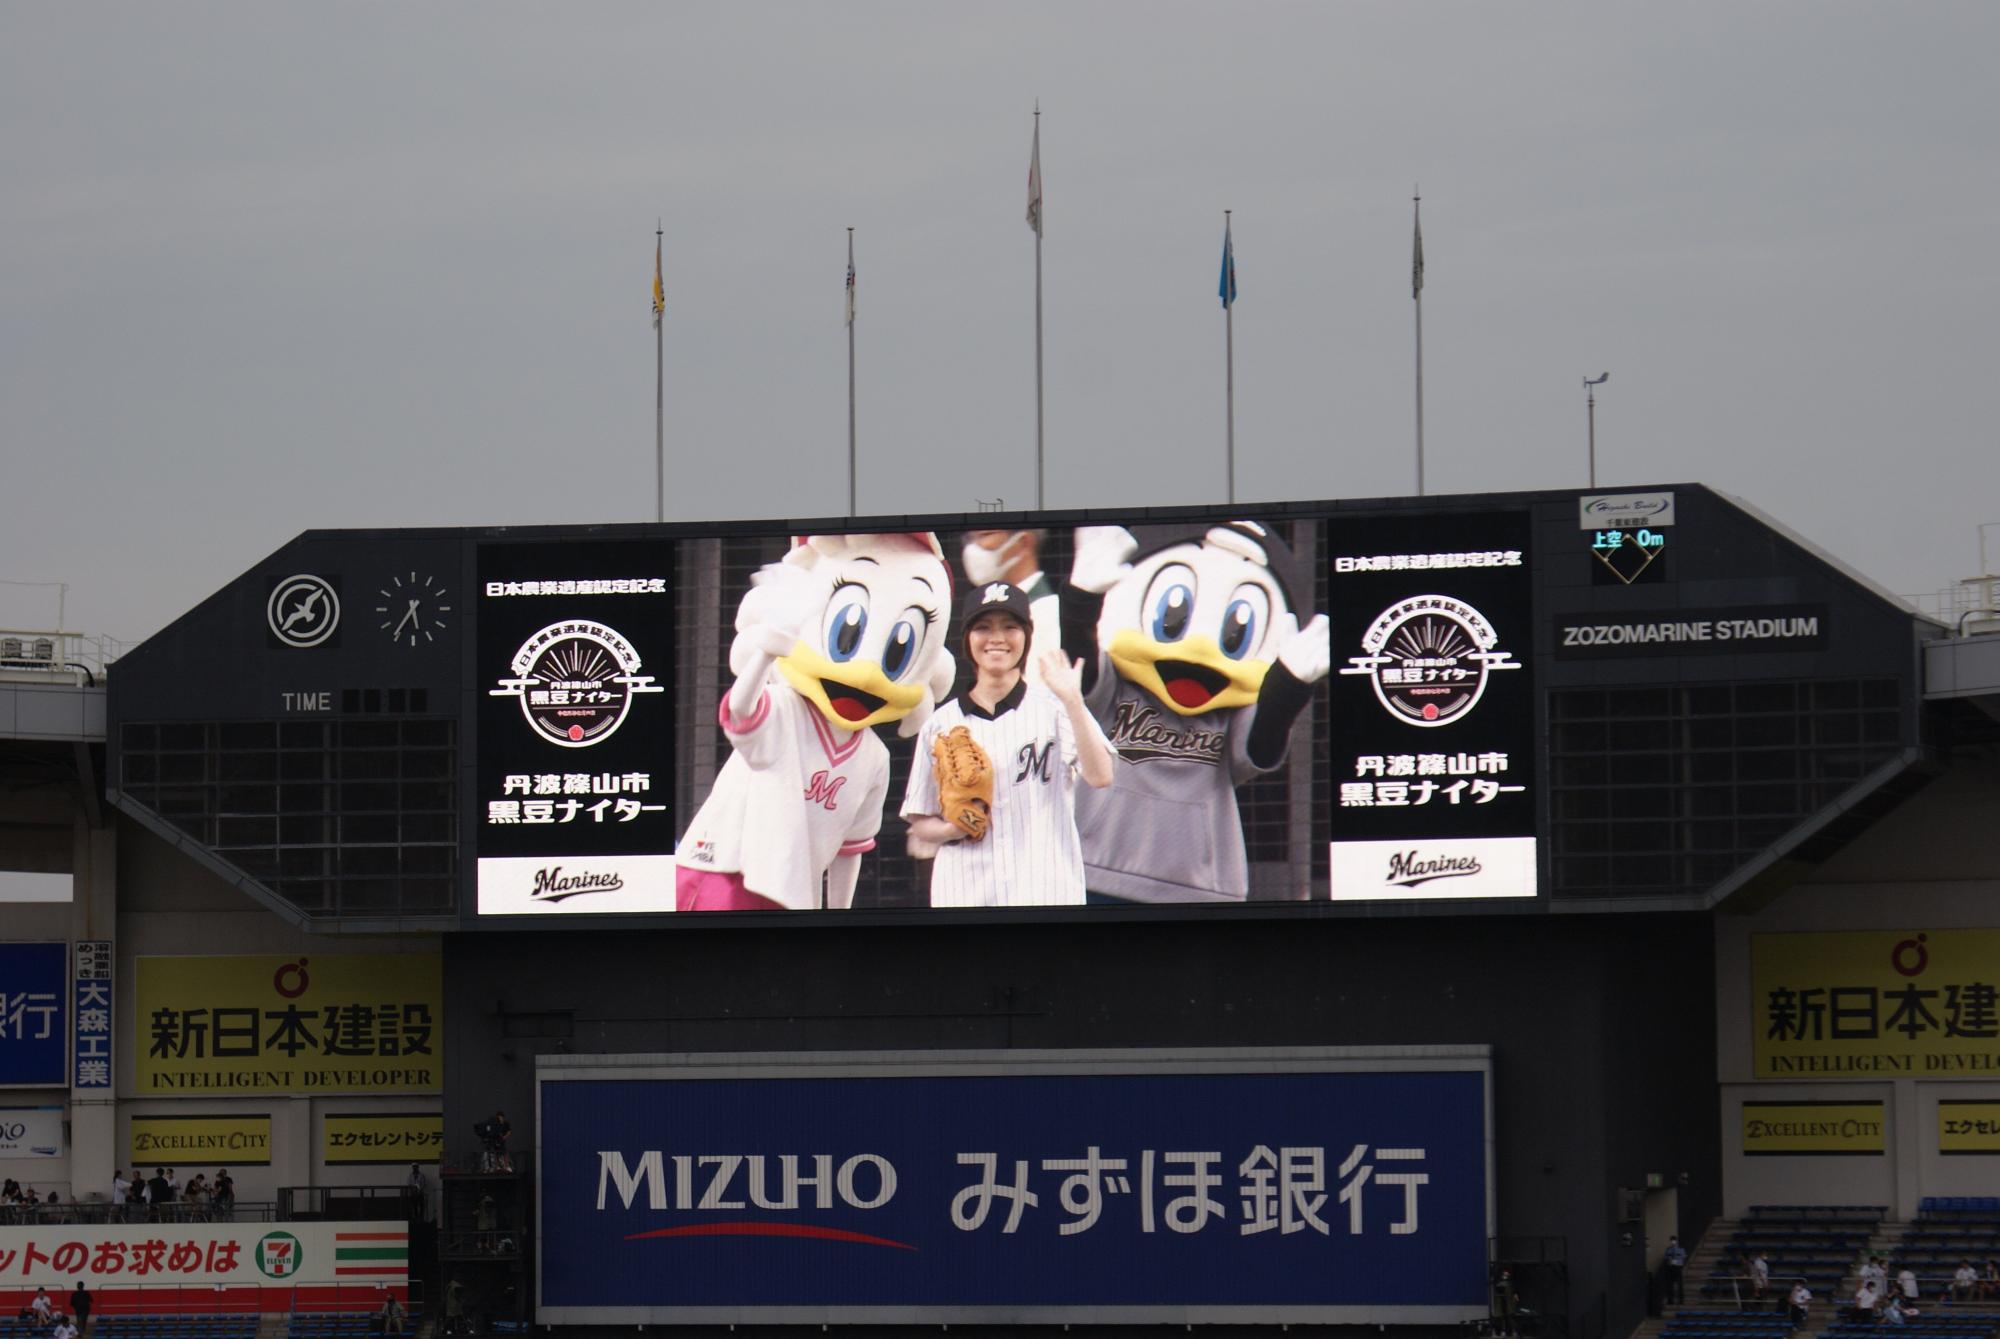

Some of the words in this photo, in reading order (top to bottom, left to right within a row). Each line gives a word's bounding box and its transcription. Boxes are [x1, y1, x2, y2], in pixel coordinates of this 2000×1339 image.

[1592, 531, 1622, 548] 上空
[1637, 530, 1664, 547] 0m
[1335, 550, 1523, 573] 日本農業遺産認定記念
[486, 579, 666, 597] 日本農業遺産認定記念
[1563, 622, 1712, 646] ZOZOMARINE
[1716, 617, 1818, 640] STADIUM
[1382, 668, 1479, 683] 黒豆ナイター
[282, 692, 331, 711] TIME
[531, 690, 623, 705] 黒豆ナイター
[1012, 737, 1056, 786] M
[1355, 752, 1509, 777] 丹波篠山市
[503, 772, 650, 796] 丹波篠山市
[804, 770, 847, 810] M
[1340, 779, 1526, 807] 黒豆ナイター
[488, 798, 667, 824] 黒豆ナイター
[1386, 850, 1481, 888] Marines
[531, 866, 623, 902] Marines
[0, 992, 58, 1040] 行
[1767, 982, 2000, 1041] 新日本建
[79, 982, 108, 1085] 大森工業
[150, 1003, 432, 1058] 新日本建設
[1771, 1054, 1915, 1073] INTELLIGENT
[1925, 1053, 2000, 1071] DEVEL
[152, 1070, 295, 1089] INTELLIGENT
[304, 1068, 432, 1087] DEVELOPER
[329, 1131, 443, 1147] エクセレントシテ
[597, 1150, 898, 1211] MIZUHO
[951, 1144, 1430, 1237] みずほ銀行
